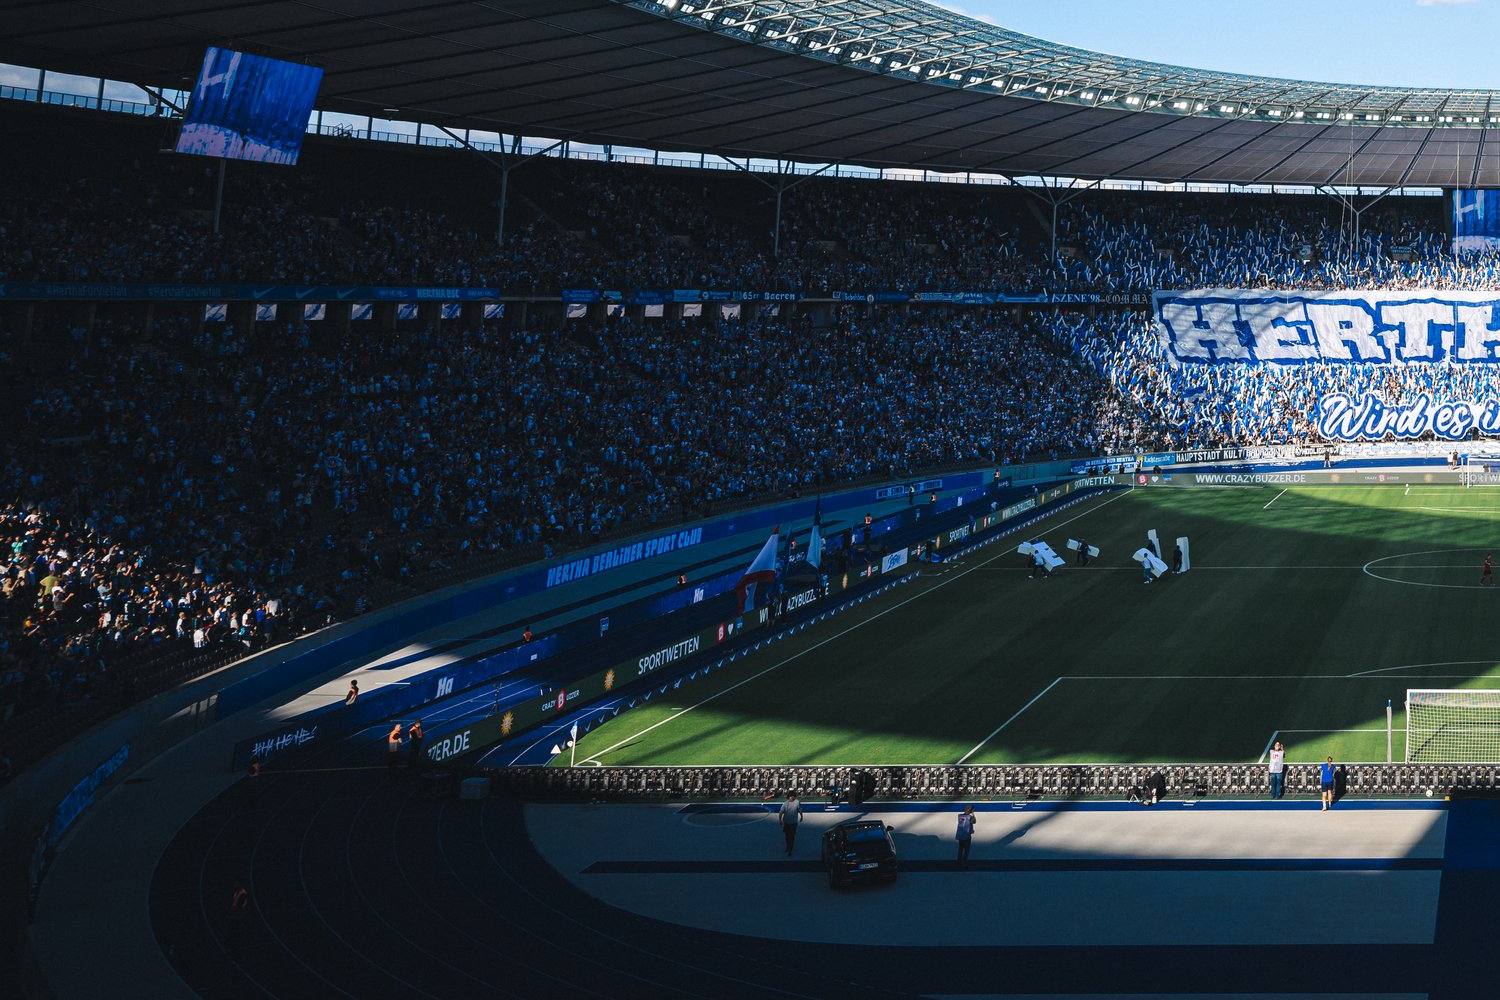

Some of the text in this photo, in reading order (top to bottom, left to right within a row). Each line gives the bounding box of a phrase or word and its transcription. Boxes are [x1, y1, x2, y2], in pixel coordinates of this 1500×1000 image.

[1322, 391, 1430, 436] Wird
[1431, 403, 1472, 435] es
[1176, 451, 1221, 463] HAUPTSTADT
[1223, 448, 1242, 460] KULT
[1195, 474, 1306, 483] WWW.CRAZYBUZZER.DE
[547, 558, 590, 588] HERTHA
[645, 533, 677, 557] SPORT
[678, 526, 703, 549] CLUB
[637, 635, 701, 676] SPORTWETTEN
